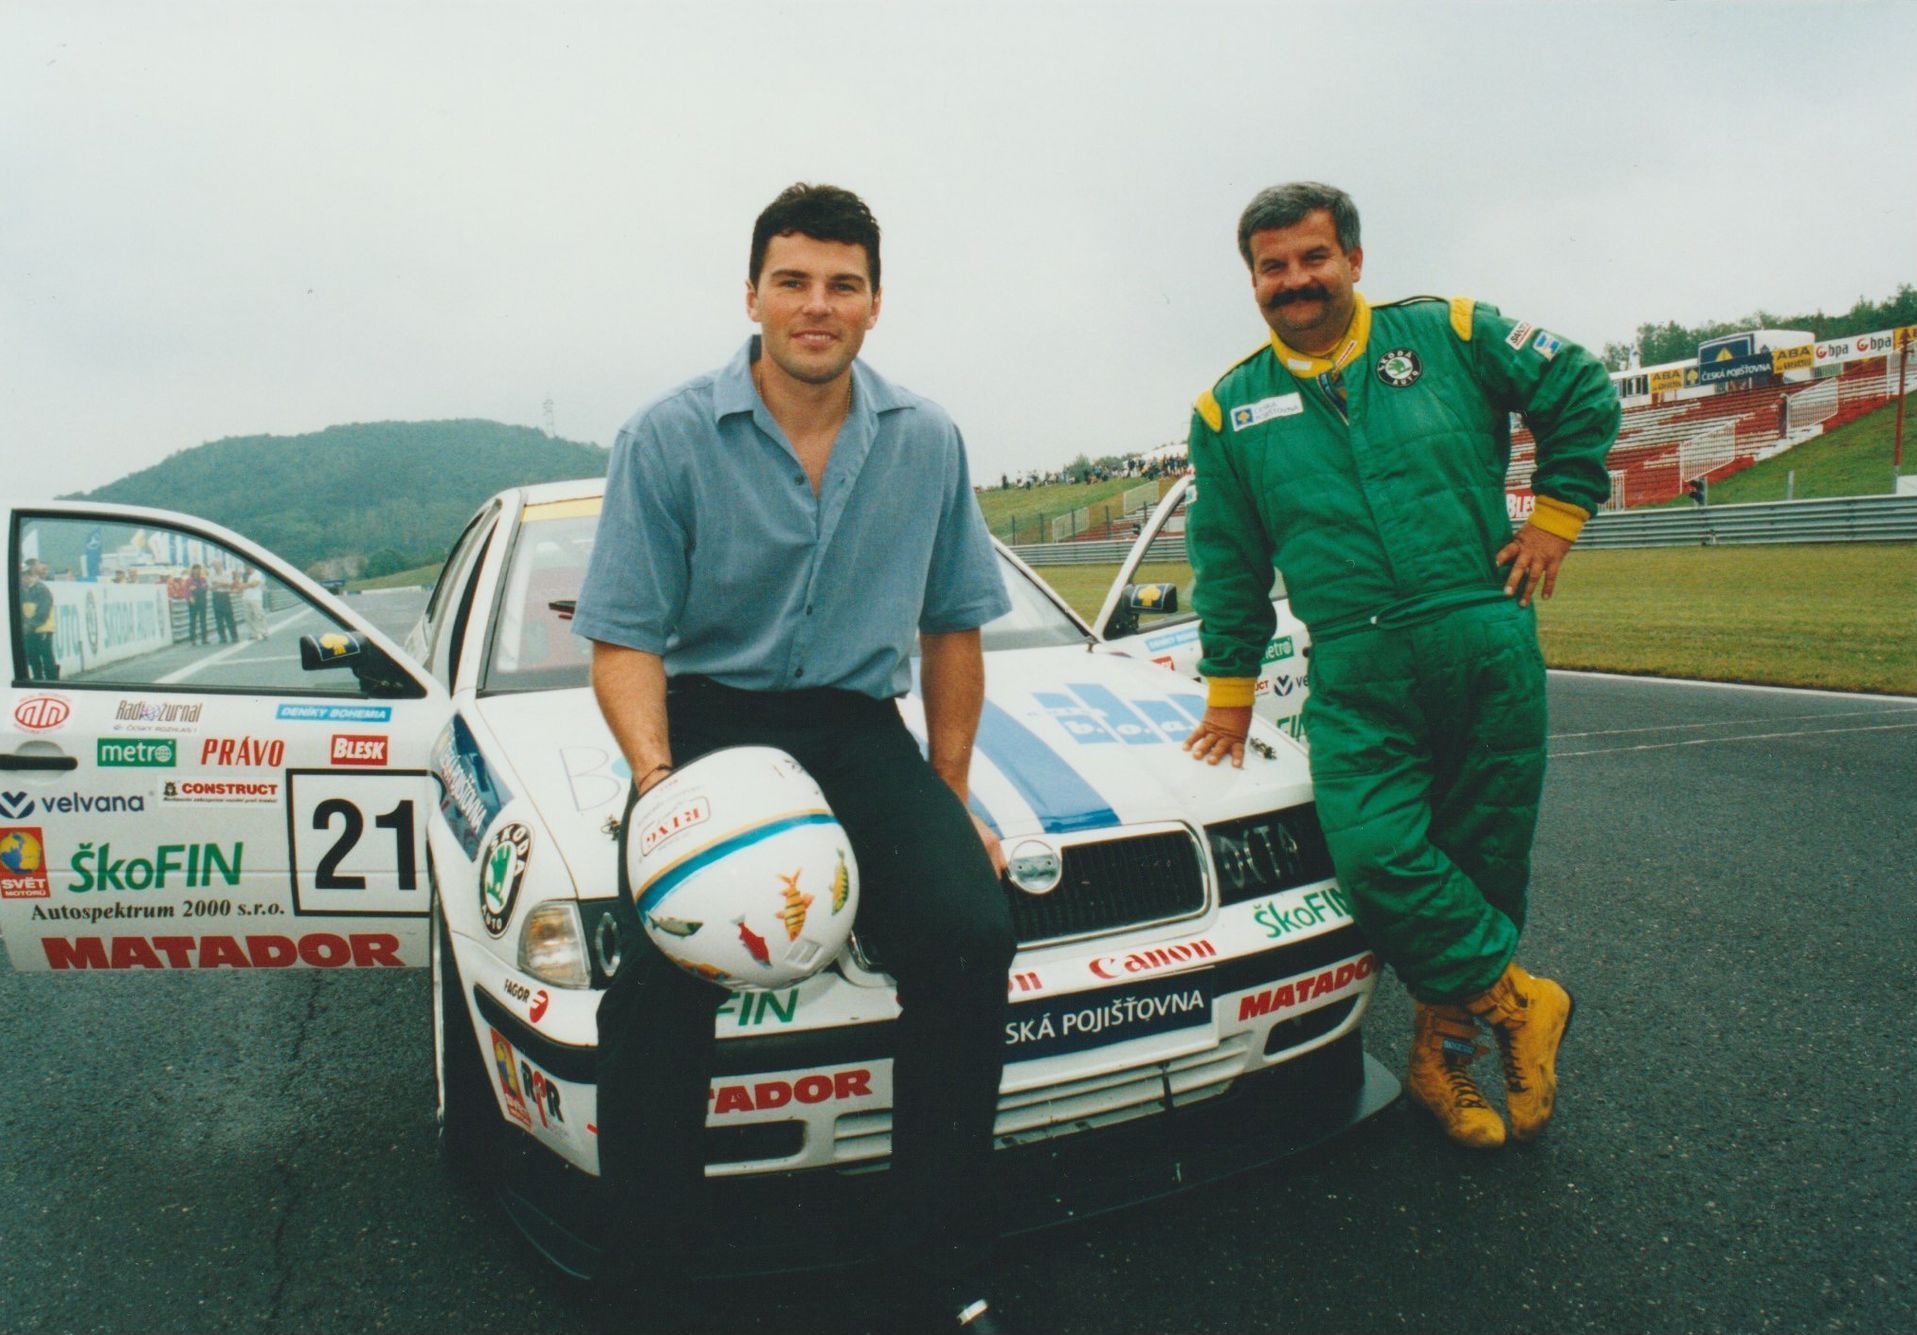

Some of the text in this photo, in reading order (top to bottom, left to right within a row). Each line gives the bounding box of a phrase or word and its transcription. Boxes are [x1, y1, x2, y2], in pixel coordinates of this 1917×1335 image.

[1776, 346, 1811, 361] ABA
[1828, 343, 1849, 358] bpa
[1869, 336, 1892, 350] bpa
[1652, 369, 1681, 381] ABA
[329, 707, 387, 719] BOHEMIA
[200, 735, 285, 767] PRÁVO
[332, 737, 385, 760] BLESK
[181, 783, 278, 796] CONSTRUCT
[41, 791, 144, 813] velvana
[312, 798, 417, 891] 21
[68, 841, 244, 893] ŠkoFIN
[1, 876, 46, 890] SVĚT
[31, 900, 285, 924] Autospektrum 2000 s.r.o.
[41, 933, 406, 969] MATADOR
[1088, 938, 1217, 980] Canon
[1238, 953, 1378, 1021] MATADO
[1005, 989, 1204, 1045] SKÁ POJIŠŤOVNA
